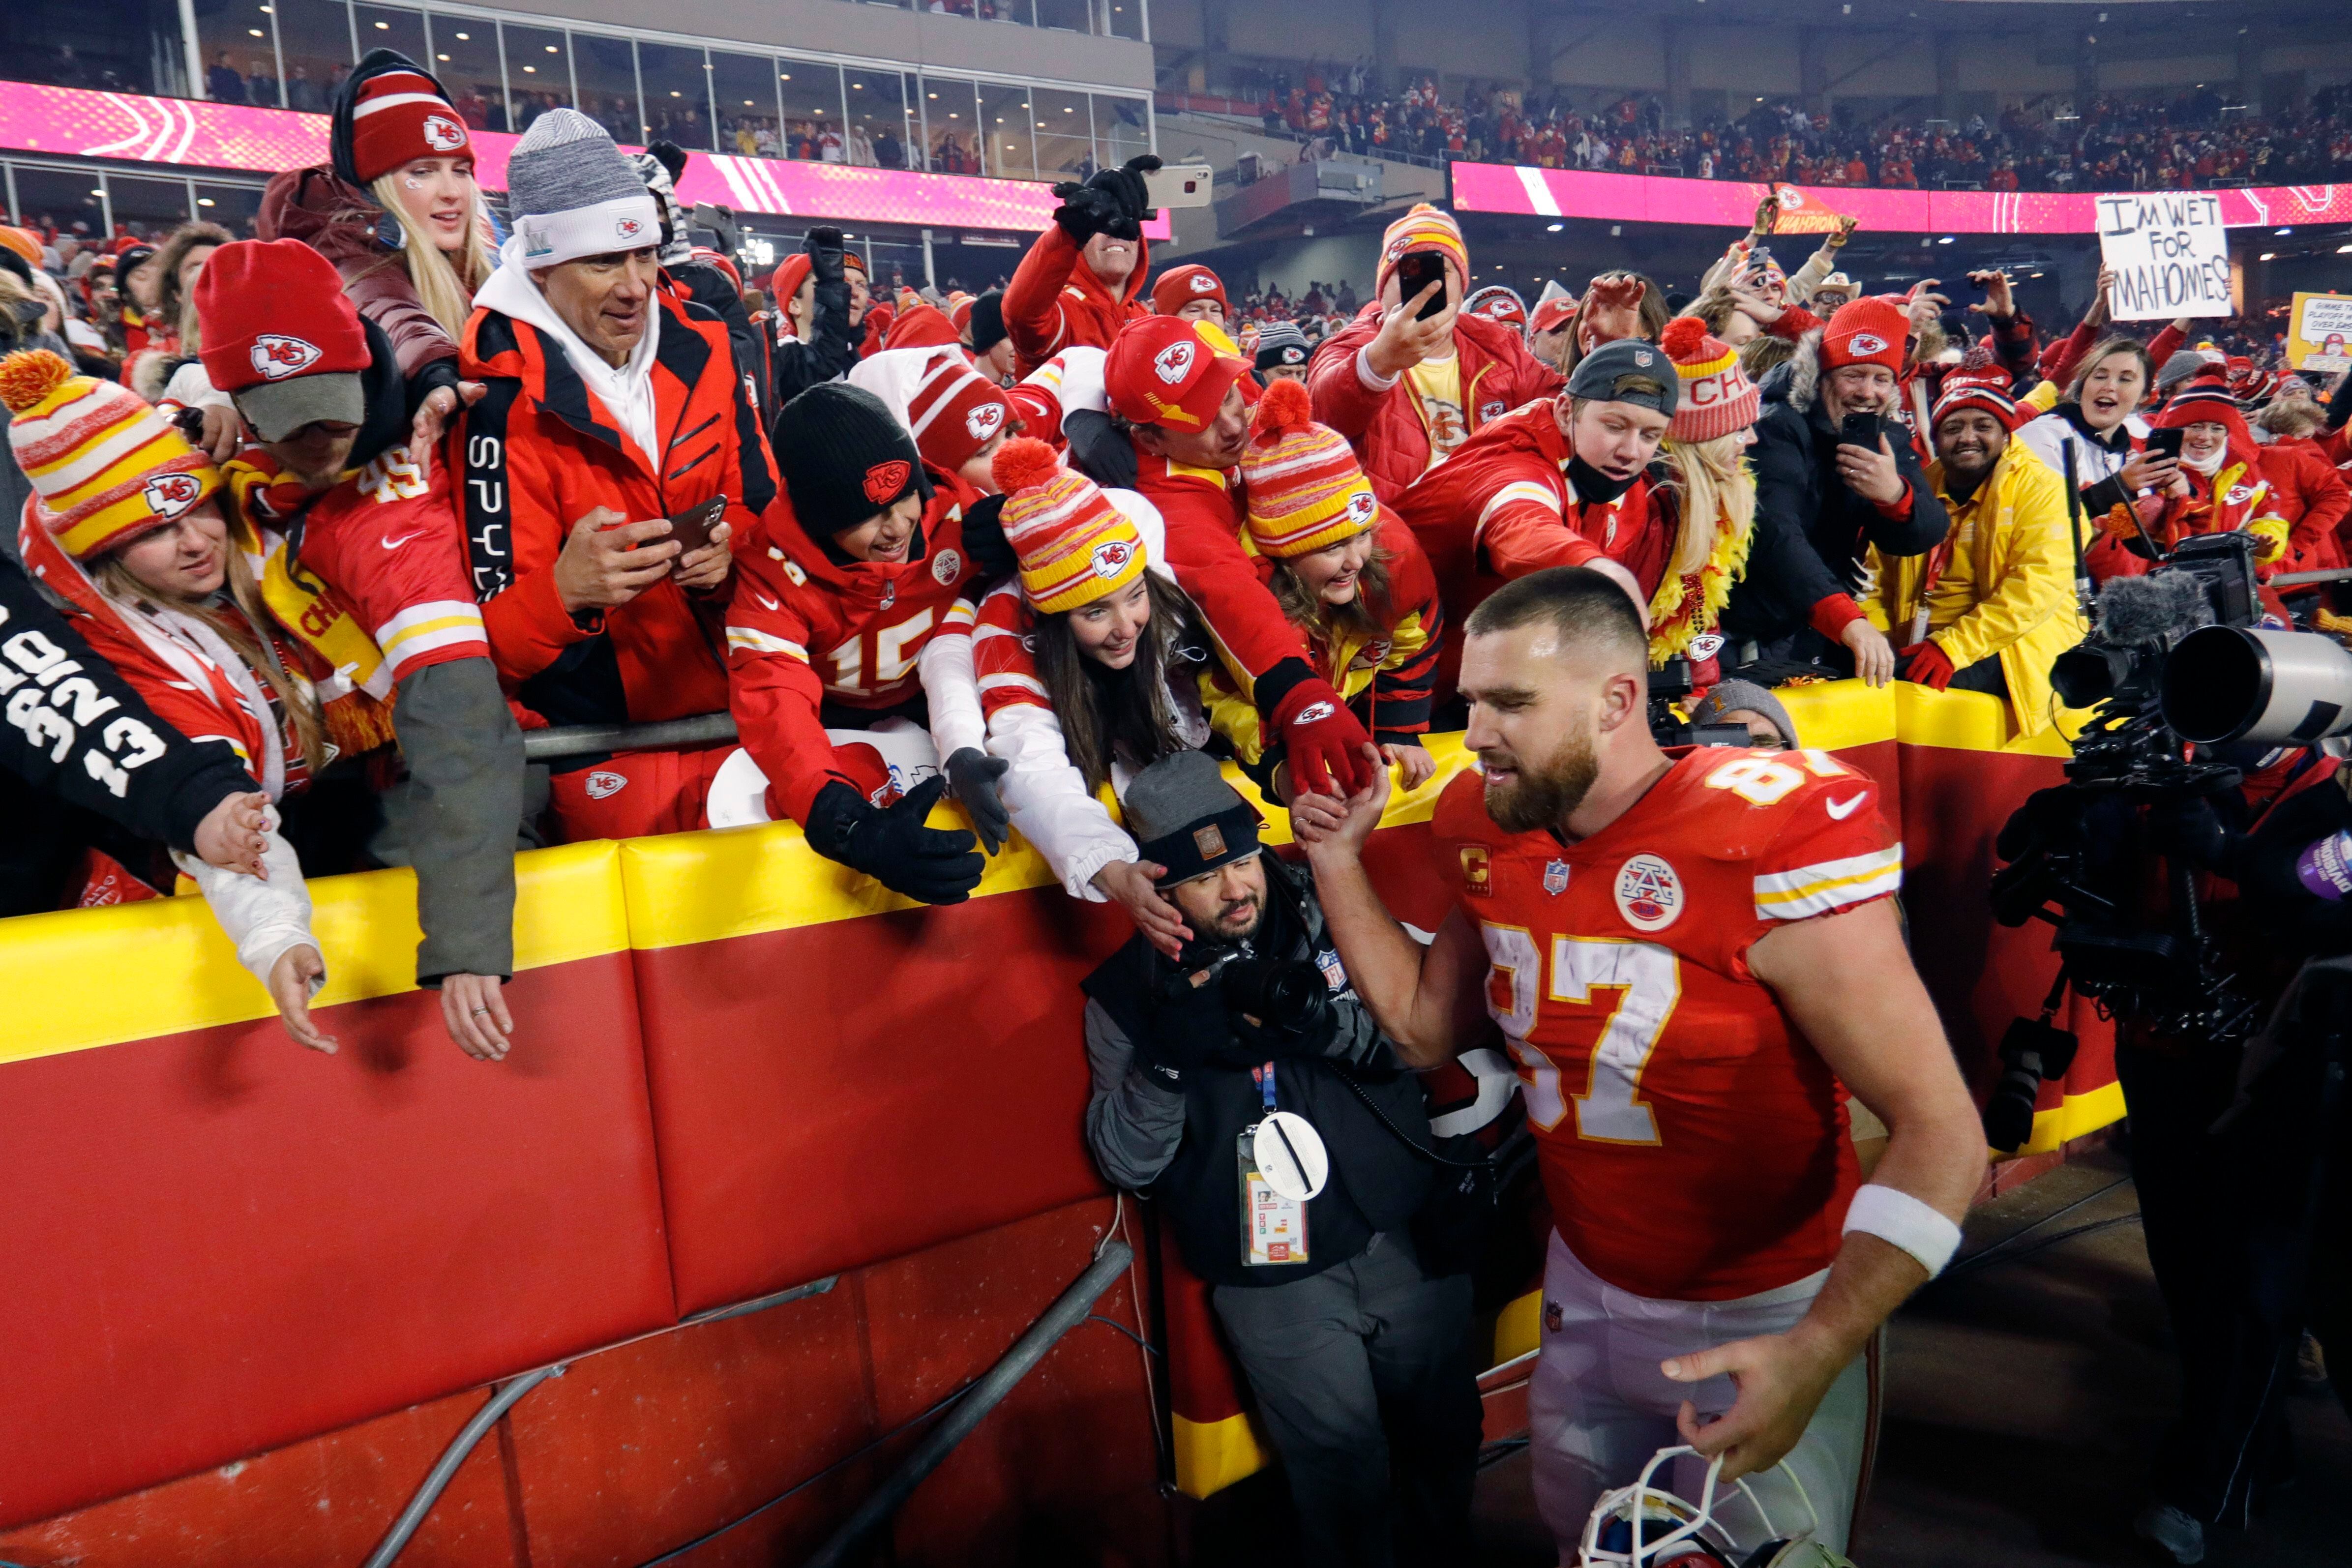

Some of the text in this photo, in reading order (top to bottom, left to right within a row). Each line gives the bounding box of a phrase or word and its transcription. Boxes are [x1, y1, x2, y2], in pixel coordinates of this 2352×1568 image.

[2100, 197, 2217, 237] I'M WET
[2149, 231, 2197, 261] FOR
[2114, 254, 2231, 316] MAHOMES
[300, 590, 342, 638] CH
[827, 606, 934, 689] 15
[1459, 848, 1488, 883] C
[1622, 862, 1674, 906] A
[1480, 918, 1683, 1147] 87
